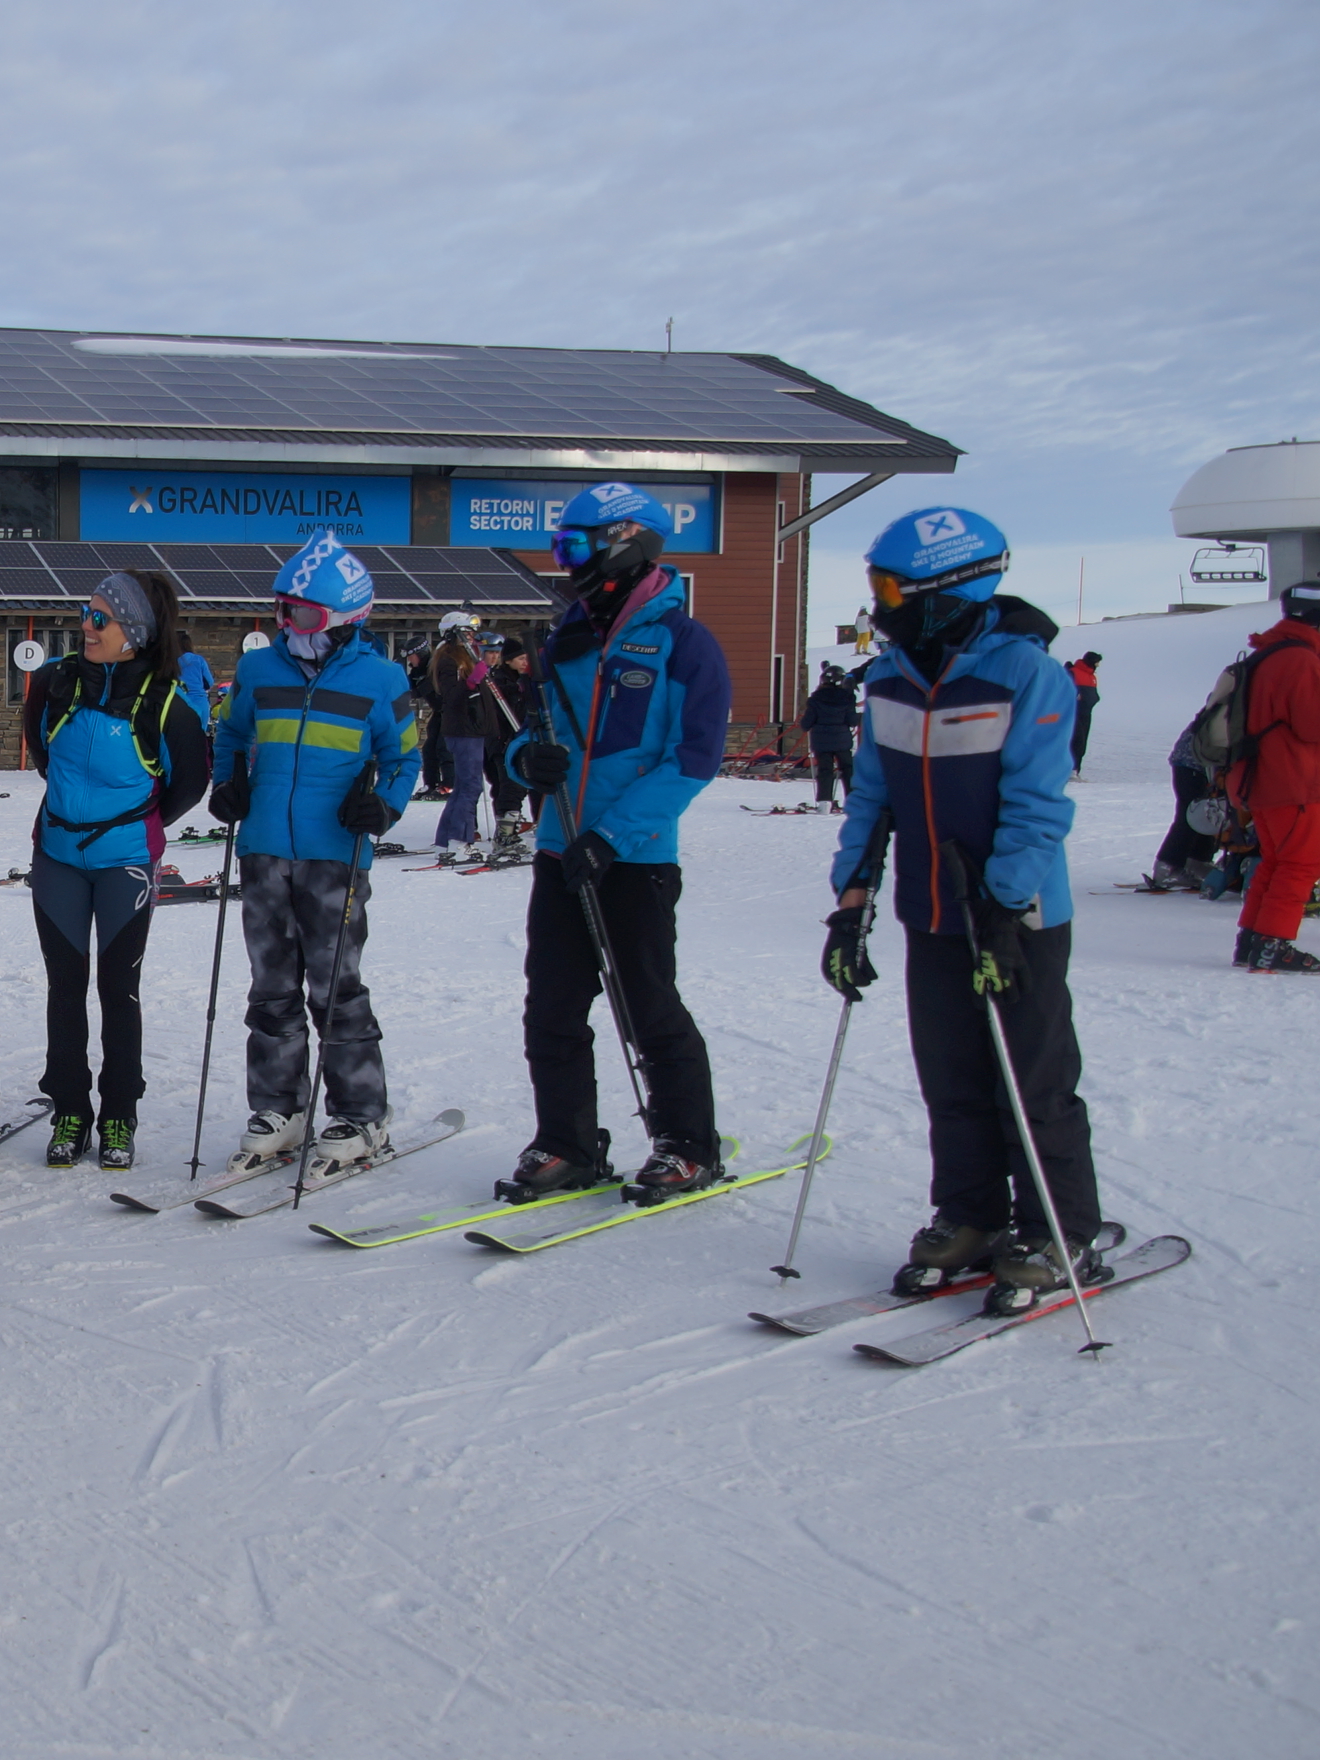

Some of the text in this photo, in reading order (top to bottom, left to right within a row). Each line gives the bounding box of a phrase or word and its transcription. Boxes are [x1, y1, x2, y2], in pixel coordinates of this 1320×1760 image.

[158, 486, 364, 518] GRANDVALIRA
[470, 499, 535, 515] RETORN
[470, 515, 533, 531] SECTOR
[913, 533, 979, 559] GRANDVALIRA
[930, 551, 972, 571] ACADEMY
[25, 647, 35, 660] D
